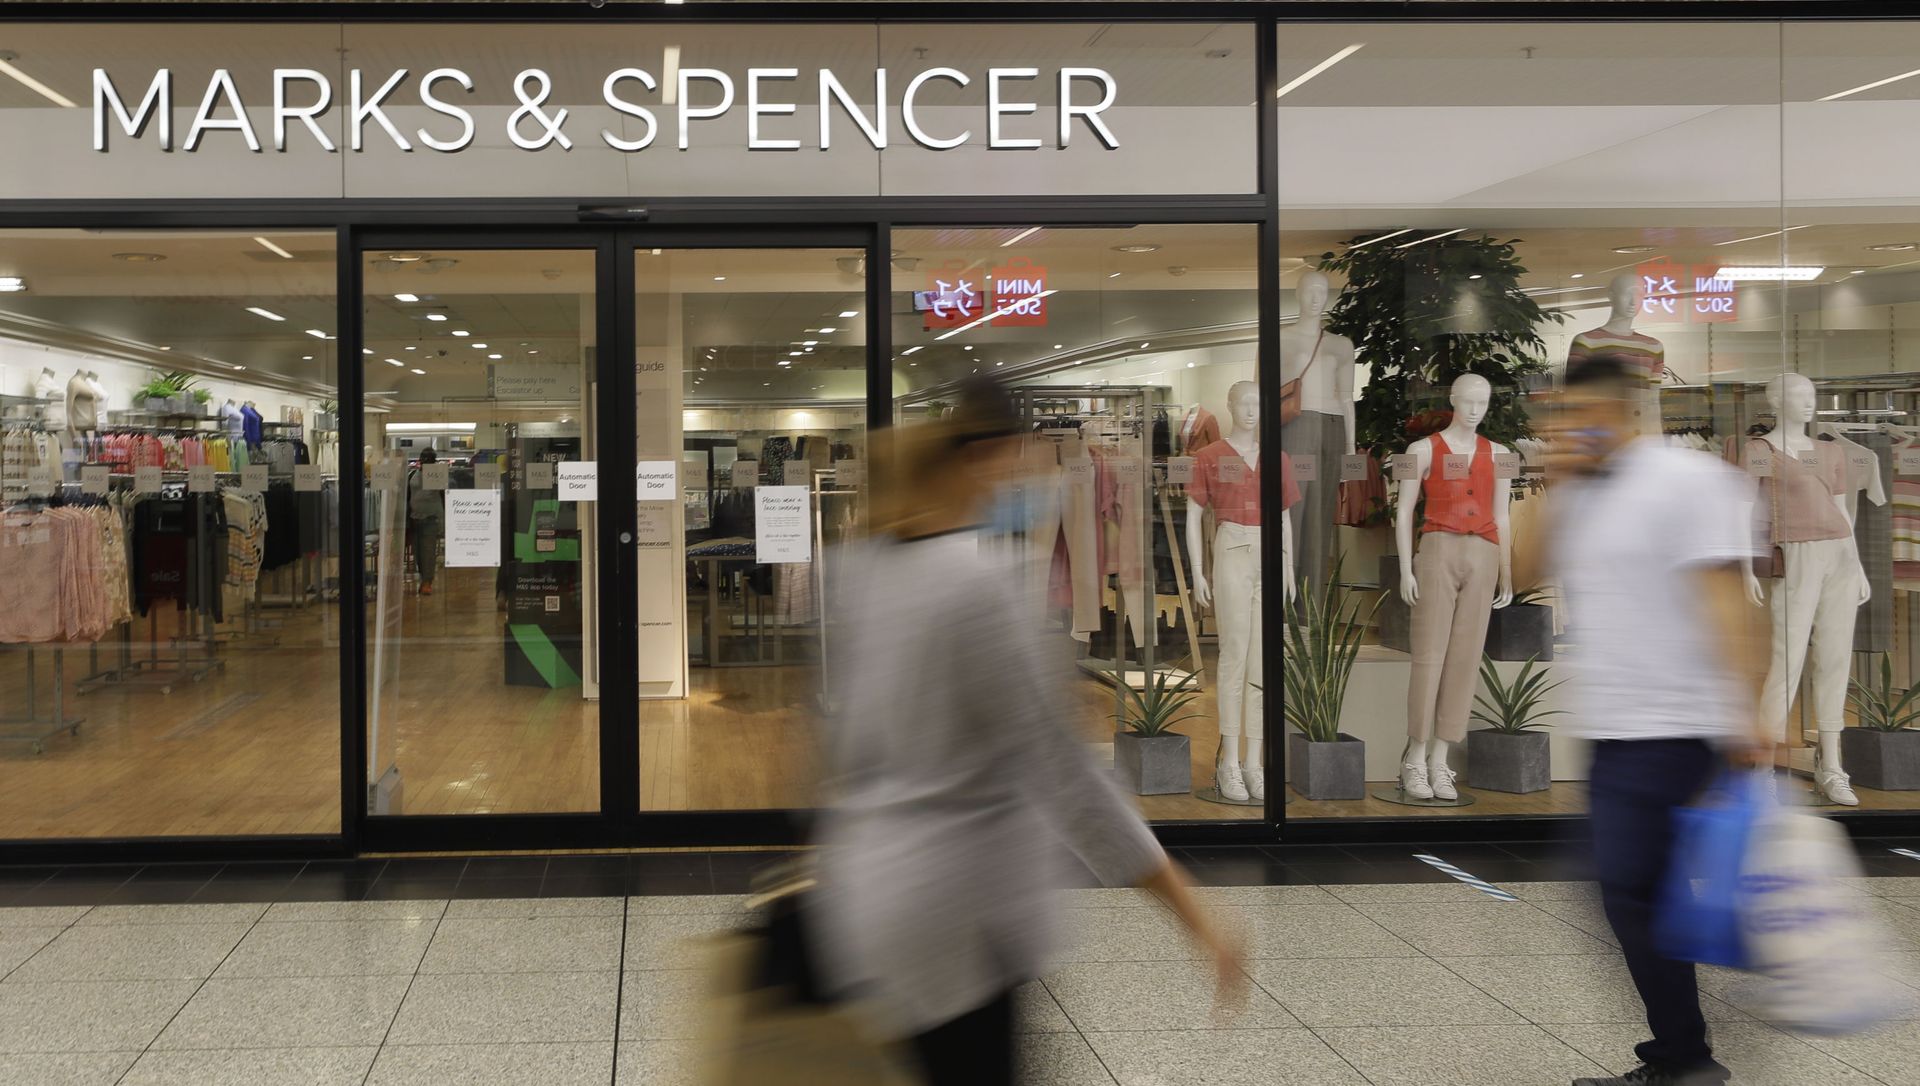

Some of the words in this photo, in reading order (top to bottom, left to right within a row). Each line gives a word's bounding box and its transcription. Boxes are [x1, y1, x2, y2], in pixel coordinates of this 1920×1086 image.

[92, 67, 476, 153] MARKS
[506, 67, 573, 152] &
[600, 67, 1121, 152] SPENCER
[636, 361, 665, 374] guide
[523, 378, 537, 386] pay
[543, 453, 567, 462] NEW
[1172, 464, 1188, 472] M&S
[1223, 464, 1240, 472] M&S
[1499, 461, 1515, 469] M&S
[87, 474, 104, 482] M&S
[246, 473, 263, 481] M&S
[299, 473, 316, 481] M&S
